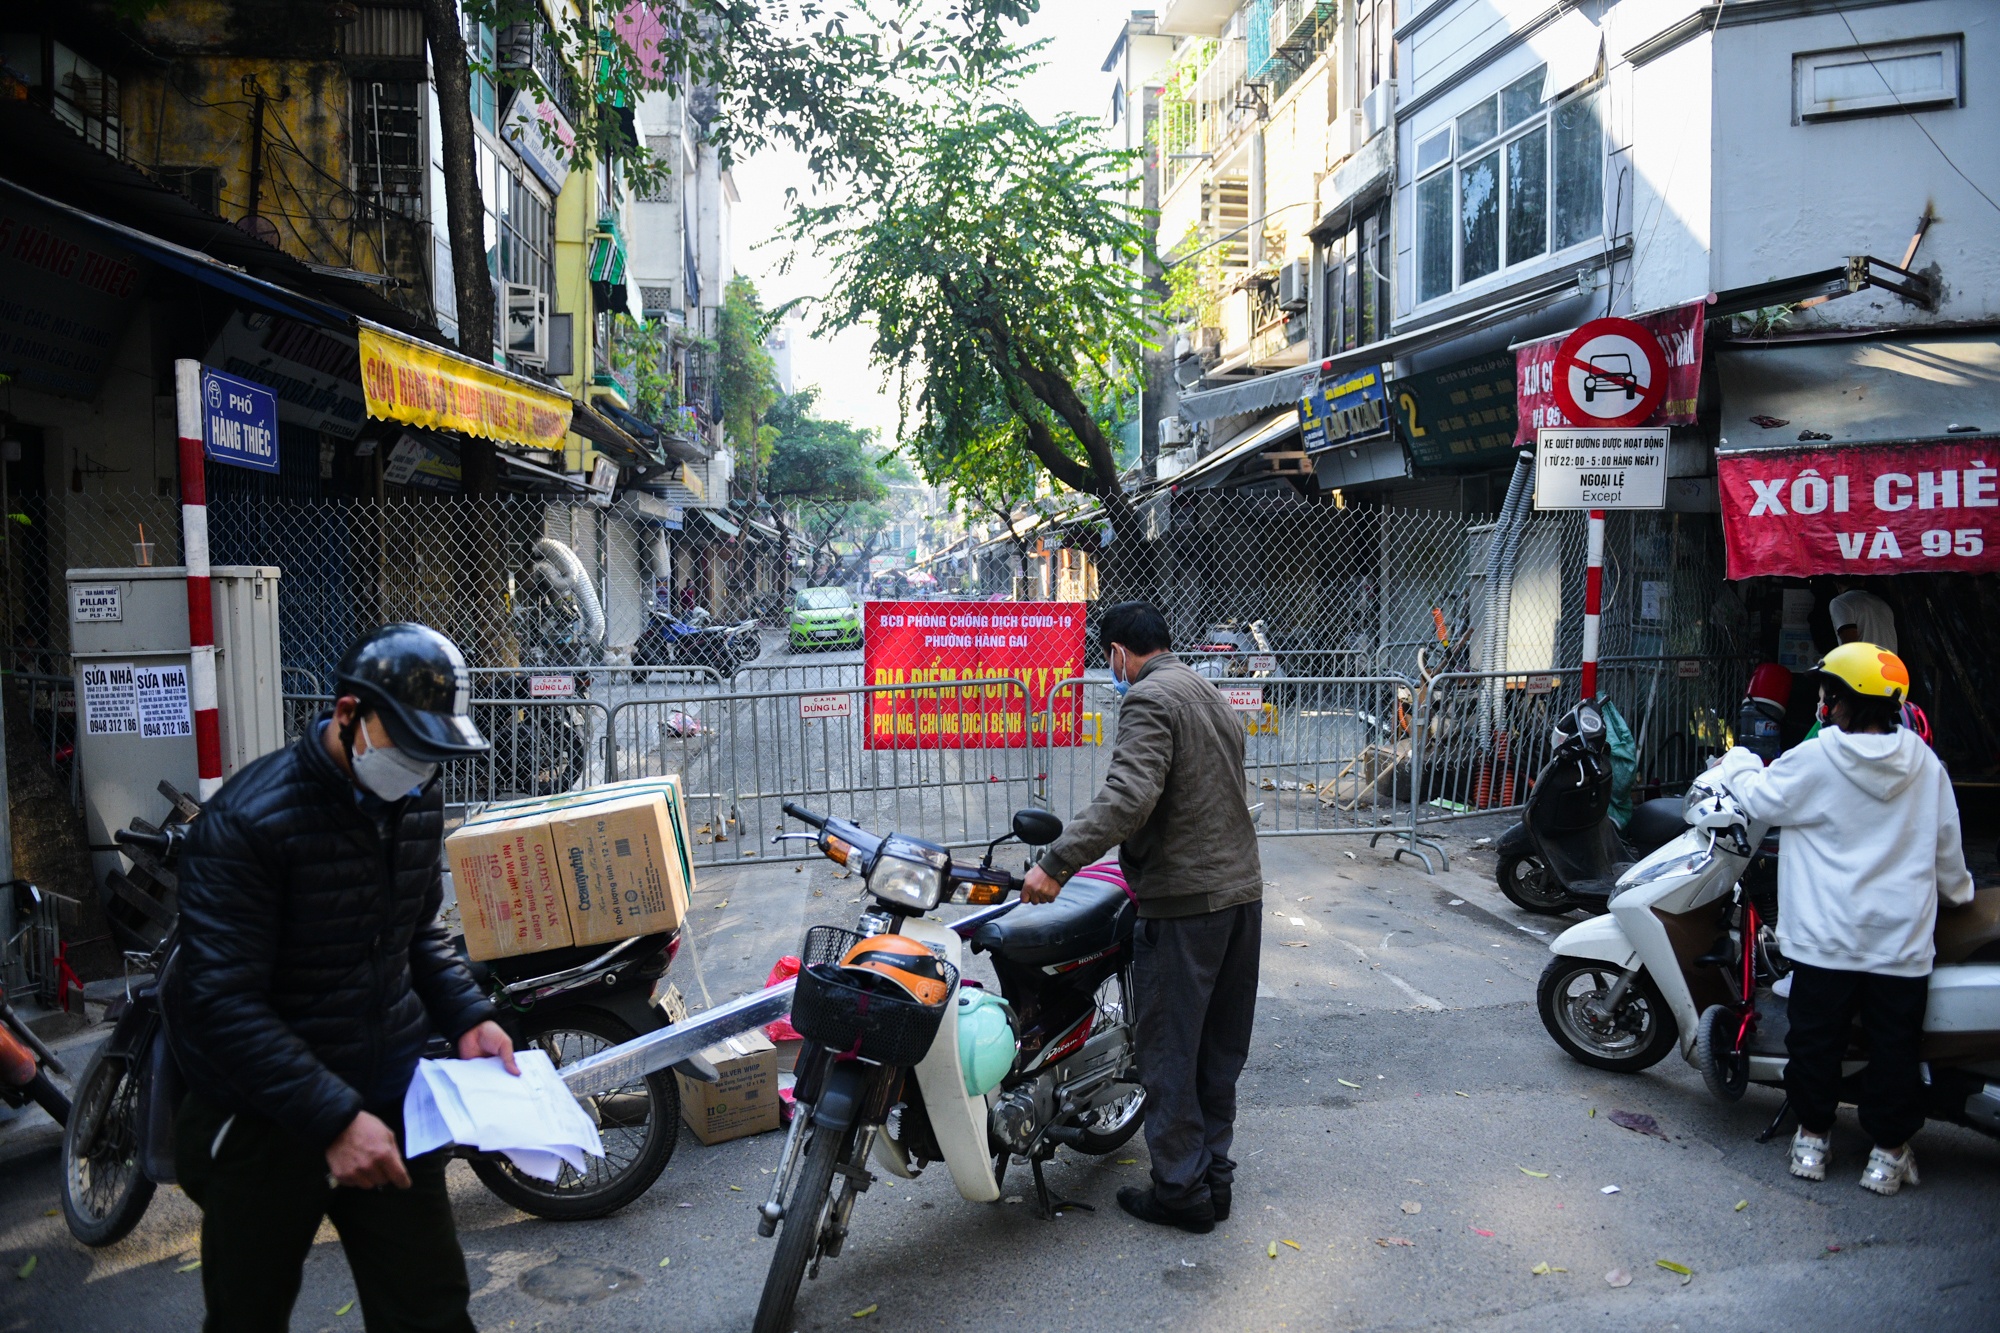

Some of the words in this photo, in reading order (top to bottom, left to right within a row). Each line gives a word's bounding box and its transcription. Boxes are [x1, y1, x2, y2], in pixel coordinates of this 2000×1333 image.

[12, 225, 80, 278] HÀNG
[78, 254, 138, 299] THIẾC
[1523, 359, 1541, 397] XÔI
[230, 393, 252, 415] PHỐ
[1400, 393, 1426, 438] 2
[1532, 404, 1545, 429] VÀ
[1546, 406, 1560, 426] 95
[212, 410, 242, 451] HÀNG
[243, 420, 272, 458] THIẾC
[1544, 439, 1553, 449] XE
[1555, 436, 1574, 449] QUÉT
[1575, 436, 1600, 449] ĐƯỜNG
[1602, 437, 1622, 450] ĐƯỢC
[1623, 438, 1642, 450] HOẠT
[1643, 436, 1664, 450] ĐỘNG
[1549, 454, 1560, 466] TỪ
[1612, 453, 1633, 466] HÀNG
[1634, 453, 1655, 466] NGÀY
[1580, 474, 1610, 489] NGOẠI
[1613, 471, 1625, 489] LỆ
[1748, 469, 1849, 517] XÔI
[1873, 460, 1999, 512] CHÈ
[1582, 490, 1622, 504] Except
[1835, 526, 1903, 560] VÀ
[1920, 529, 1984, 558] 95
[80, 598, 108, 606] PILLAR
[110, 597, 115, 605] 3
[906, 613, 946, 628] PHÒNG
[949, 611, 989, 628] CHỐNG
[991, 615, 1019, 631] DỊCH
[1021, 615, 1072, 628] COVID-19
[924, 632, 972, 648] PHƯỜNG
[974, 631, 1006, 647] HÀNG
[1008, 635, 1028, 647] GAI
[85, 665, 107, 686] SỬA
[110, 666, 134, 685] NHÀ
[137, 669, 160, 690] SỬA
[162, 669, 186, 688] NHÀ
[874, 668, 905, 706] ĐỊA
[911, 655, 956, 699] ĐIỂM
[1037, 668, 1049, 698] Y
[803, 702, 830, 713] DỪNG
[90, 720, 107, 733] 0948
[109, 719, 122, 732] 312
[123, 718, 137, 731] 186
[143, 723, 161, 736] 0948
[162, 722, 176, 735] 312
[177, 721, 190, 734] 186
[597, 821, 606, 832] Kg
[502, 844, 512, 859] Net
[516, 836, 525, 853] Non
[601, 848, 609, 858] 12
[506, 861, 518, 891] Weight
[519, 855, 529, 877] Dairy
[605, 864, 614, 881] tịnh
[534, 844, 552, 892] GOLDEN
[544, 895, 559, 927] PEAK
[568, 846, 591, 912] Creamywhip
[524, 880, 537, 912] Topping
[609, 881, 619, 906] lượng
[513, 899, 523, 909] 12
[531, 914, 543, 940] Cream
[612, 908, 623, 926] Khối
[518, 927, 527, 938] Kg
[1078, 951, 1103, 965] HONDA
[1044, 1038, 1078, 1061] Dream
[720, 1068, 742, 1080] SILVER
[743, 1063, 760, 1073] WHIP
